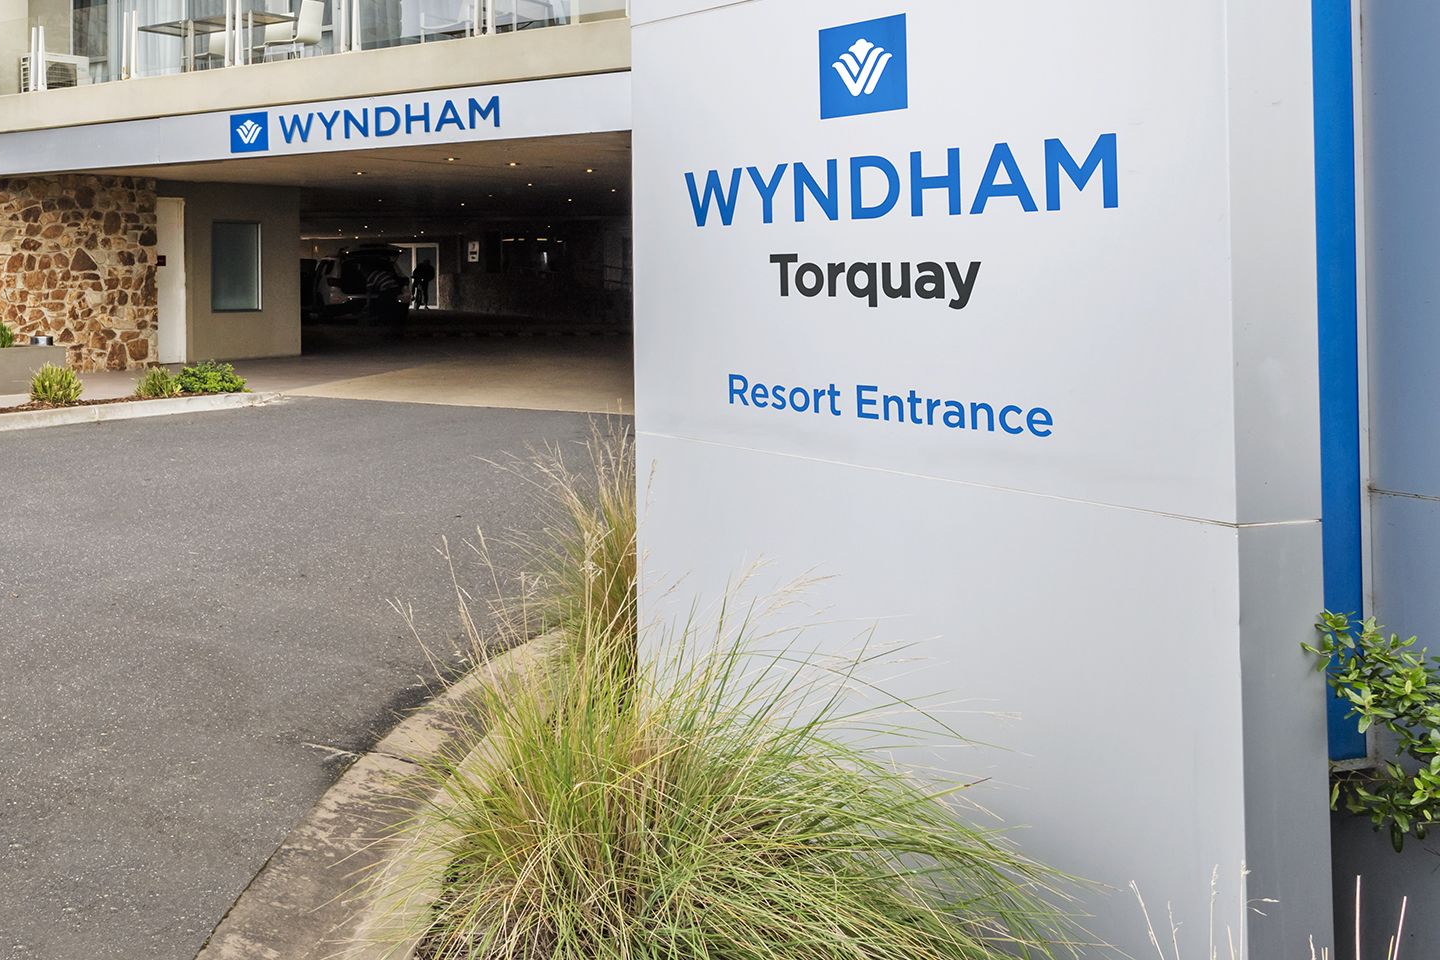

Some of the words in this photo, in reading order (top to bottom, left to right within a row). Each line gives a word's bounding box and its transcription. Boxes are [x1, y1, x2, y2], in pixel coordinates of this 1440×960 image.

[279, 95, 501, 144] WYNDHAM
[684, 132, 1119, 228] WYNDHAM
[769, 253, 982, 310] Torquay
[728, 373, 842, 417] Resort
[856, 384, 1054, 438] Entrance
